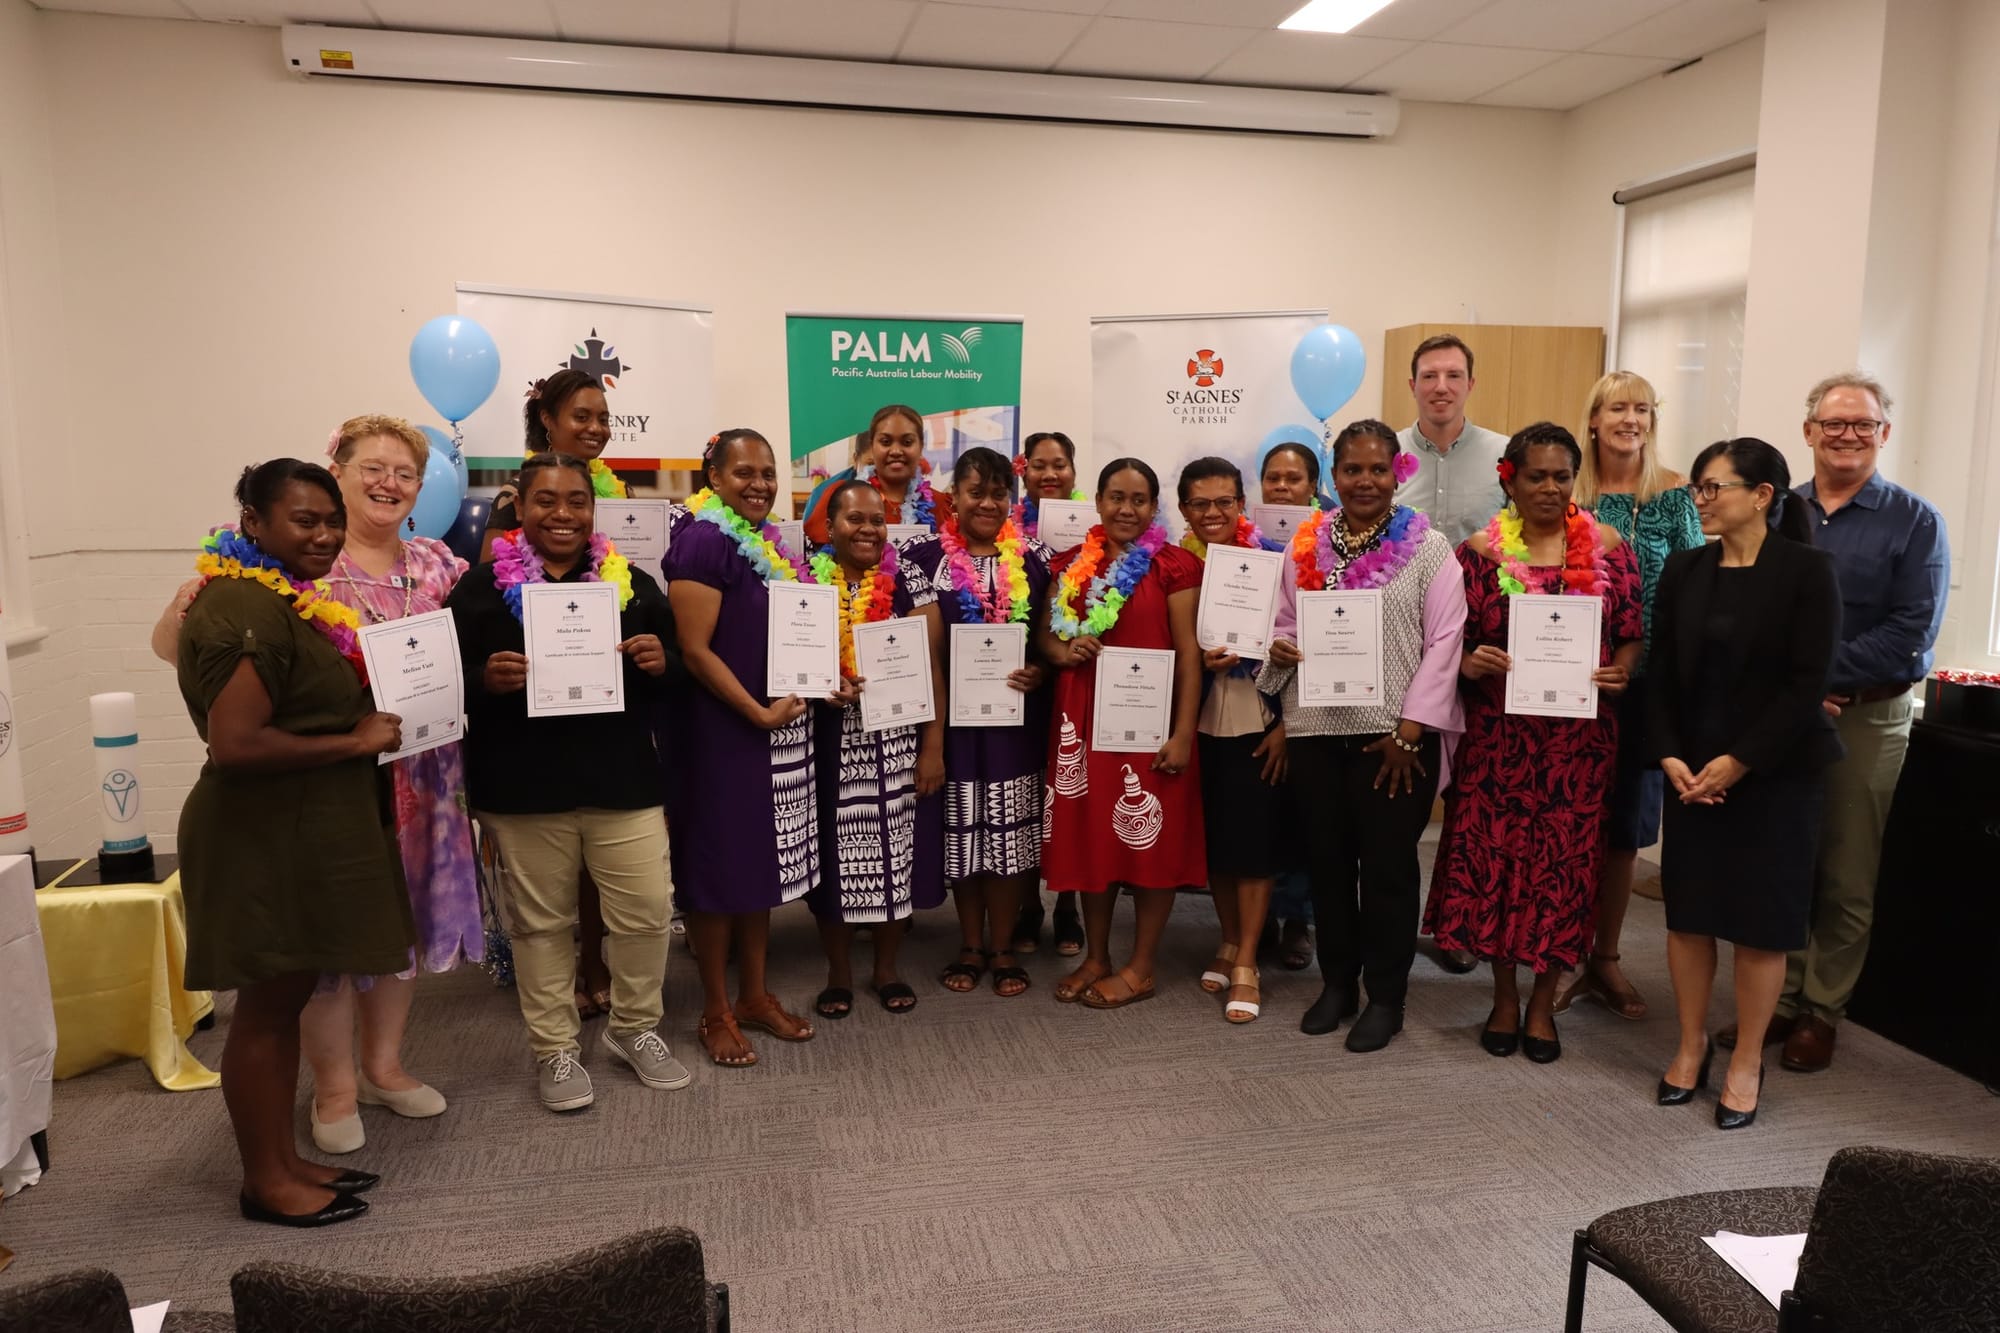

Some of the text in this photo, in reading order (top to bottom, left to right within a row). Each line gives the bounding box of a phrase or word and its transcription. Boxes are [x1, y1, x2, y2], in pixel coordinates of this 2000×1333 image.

[831, 330, 932, 363] PALM
[832, 367, 983, 382] Pacific Australia Labour Mobility
[1172, 406, 1237, 415] CATHOLIC
[609, 414, 650, 433] ENRY
[1181, 416, 1227, 424] PARISH
[610, 432, 637, 442] UTE
